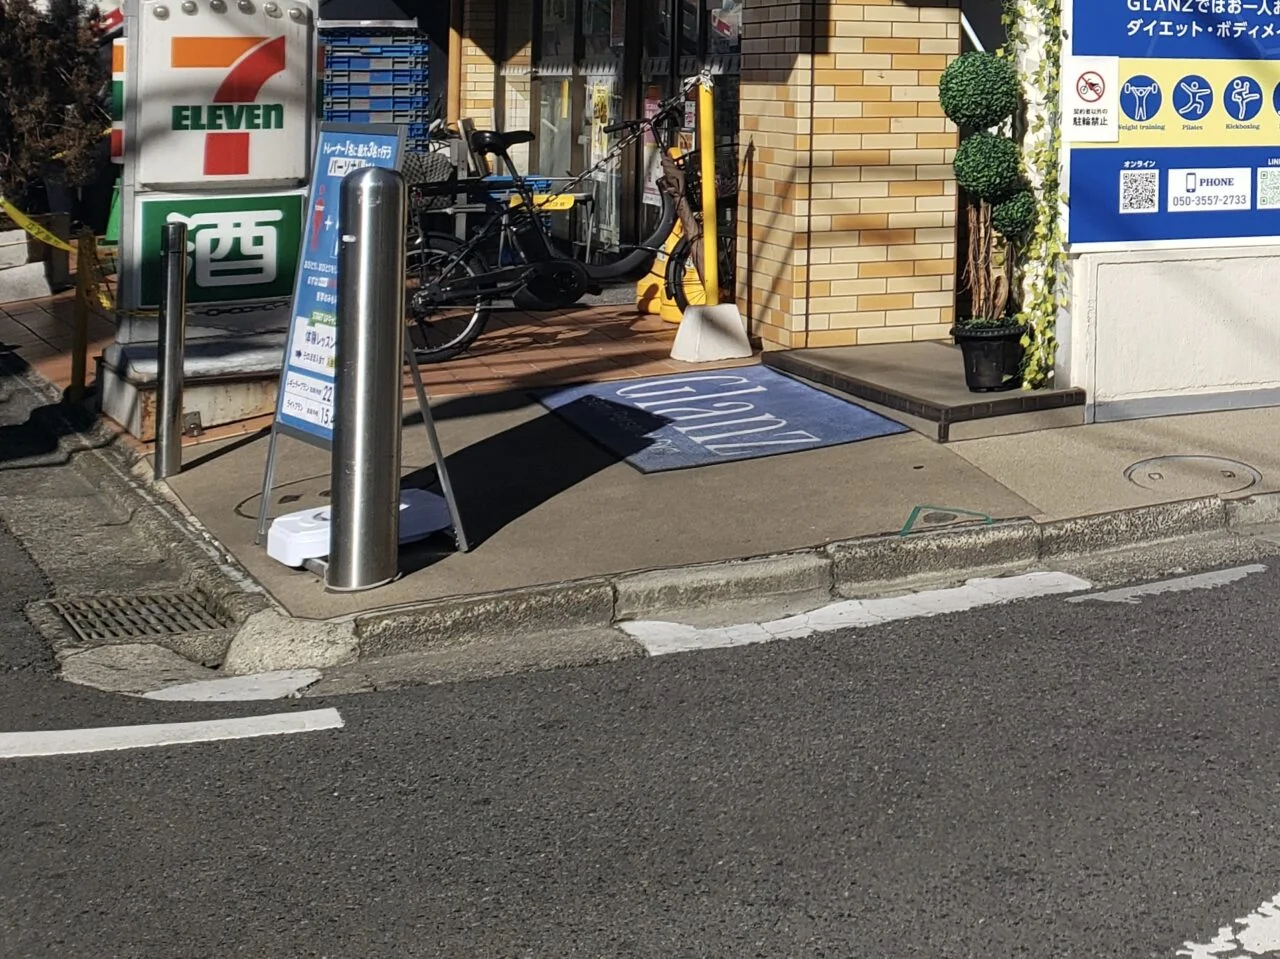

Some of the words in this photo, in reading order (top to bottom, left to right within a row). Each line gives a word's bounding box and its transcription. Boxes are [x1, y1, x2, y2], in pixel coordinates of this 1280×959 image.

[1072, 116, 1109, 127] 駐輪禁止
[1139, 123, 1166, 131] training
[1181, 123, 1203, 131] Pilates
[1225, 123, 1261, 131] Kickboxing
[1123, 160, 1156, 168] オンライン
[1200, 177, 1235, 187] PHONE
[1172, 194, 1247, 207] 050-3557-2733
[165, 210, 283, 287] 酒
[616, 375, 822, 457] Glanz
